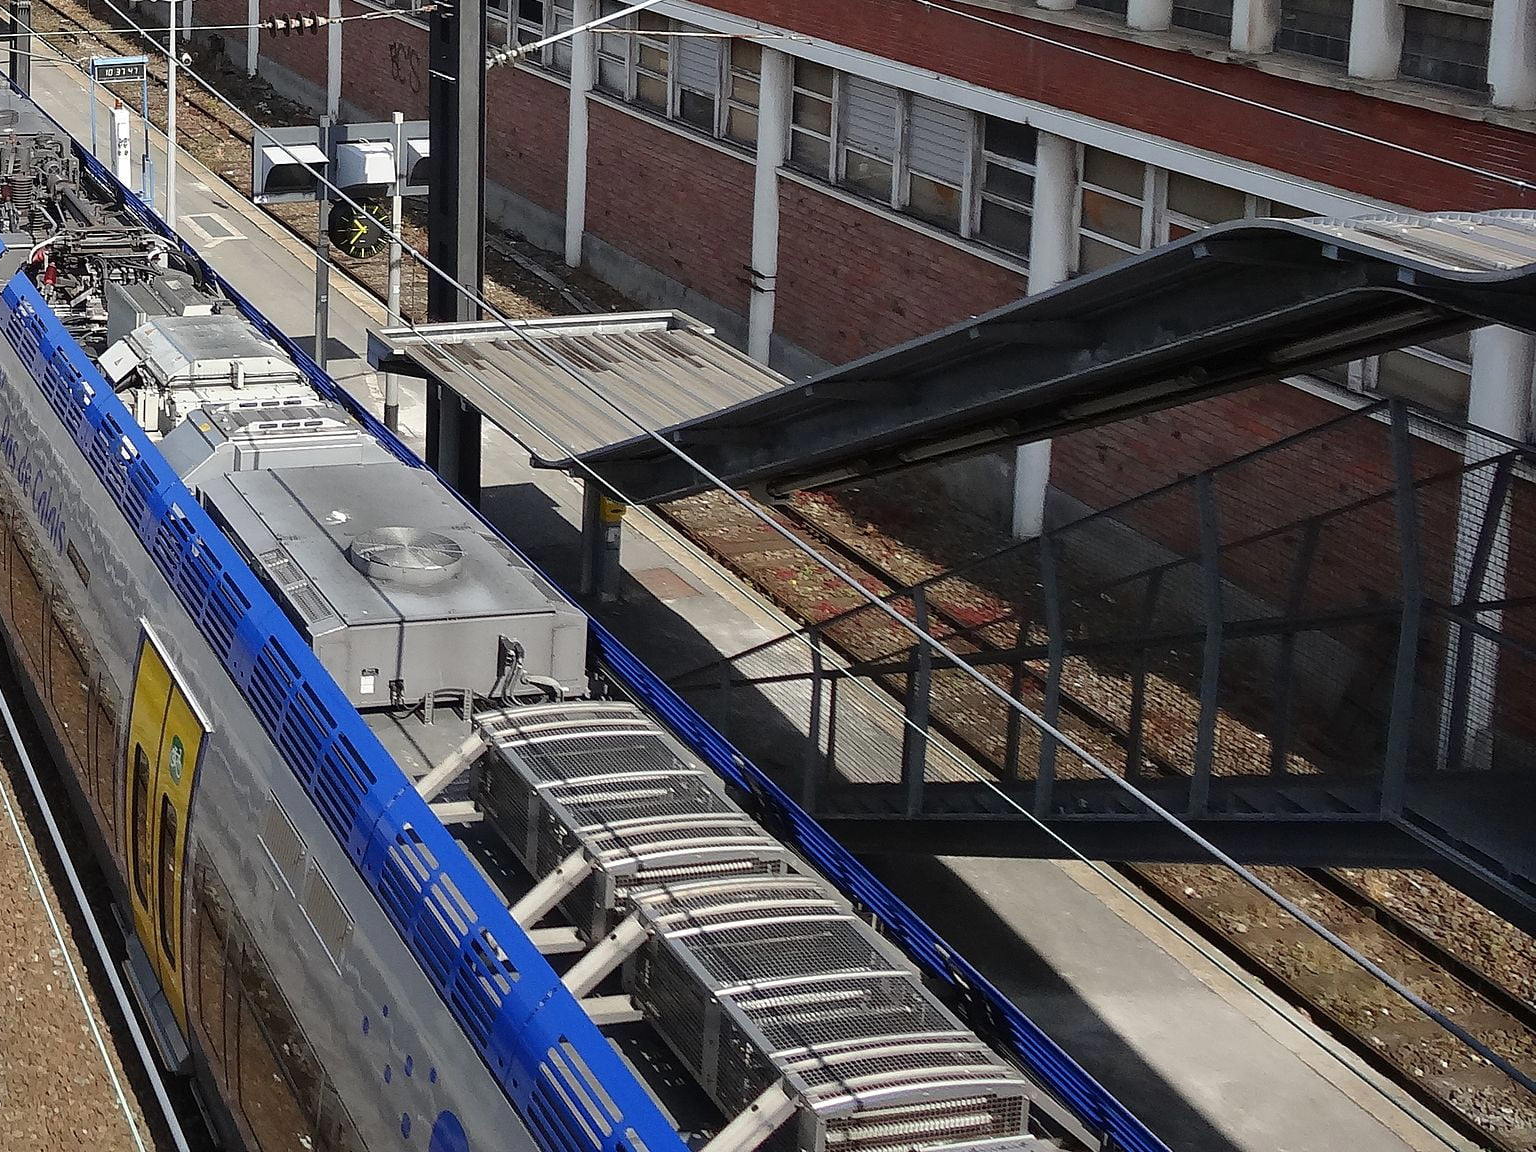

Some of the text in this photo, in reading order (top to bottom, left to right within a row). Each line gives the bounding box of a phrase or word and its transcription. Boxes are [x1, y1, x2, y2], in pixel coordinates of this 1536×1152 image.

[105, 66, 139, 77] 10 37 47
[32, 468, 66, 557] Calais
